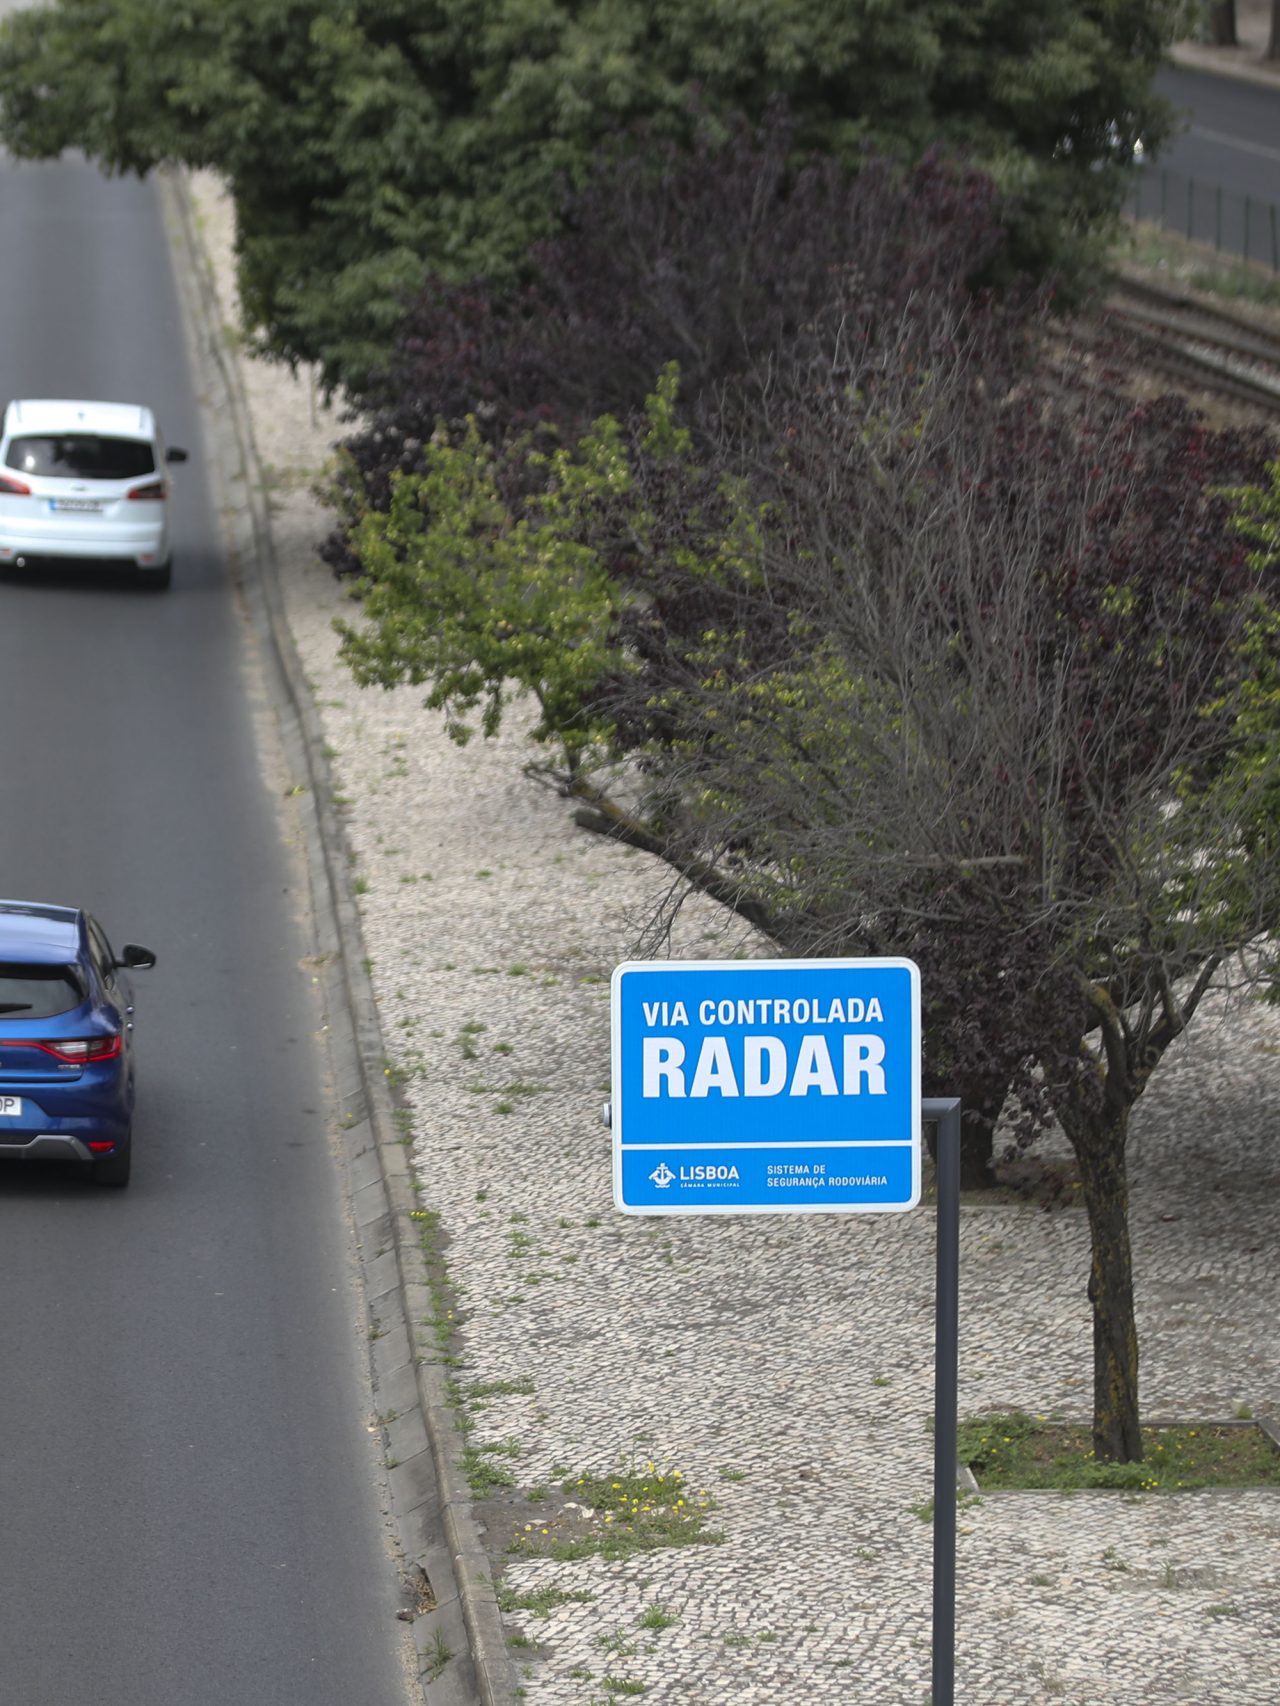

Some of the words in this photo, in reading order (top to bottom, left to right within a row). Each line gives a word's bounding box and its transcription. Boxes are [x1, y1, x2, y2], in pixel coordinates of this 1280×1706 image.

[642, 1001, 689, 1027] VIA
[699, 997, 884, 1025] CONTROLADA
[642, 1034, 888, 1098] RADAR
[680, 1165, 740, 1181] LISBOA
[767, 1165, 810, 1175] SISTEMA
[813, 1164, 826, 1174] DE
[767, 1176, 826, 1188] SEGURANÇA
[828, 1175, 888, 1186] RODOVIÁRIA
